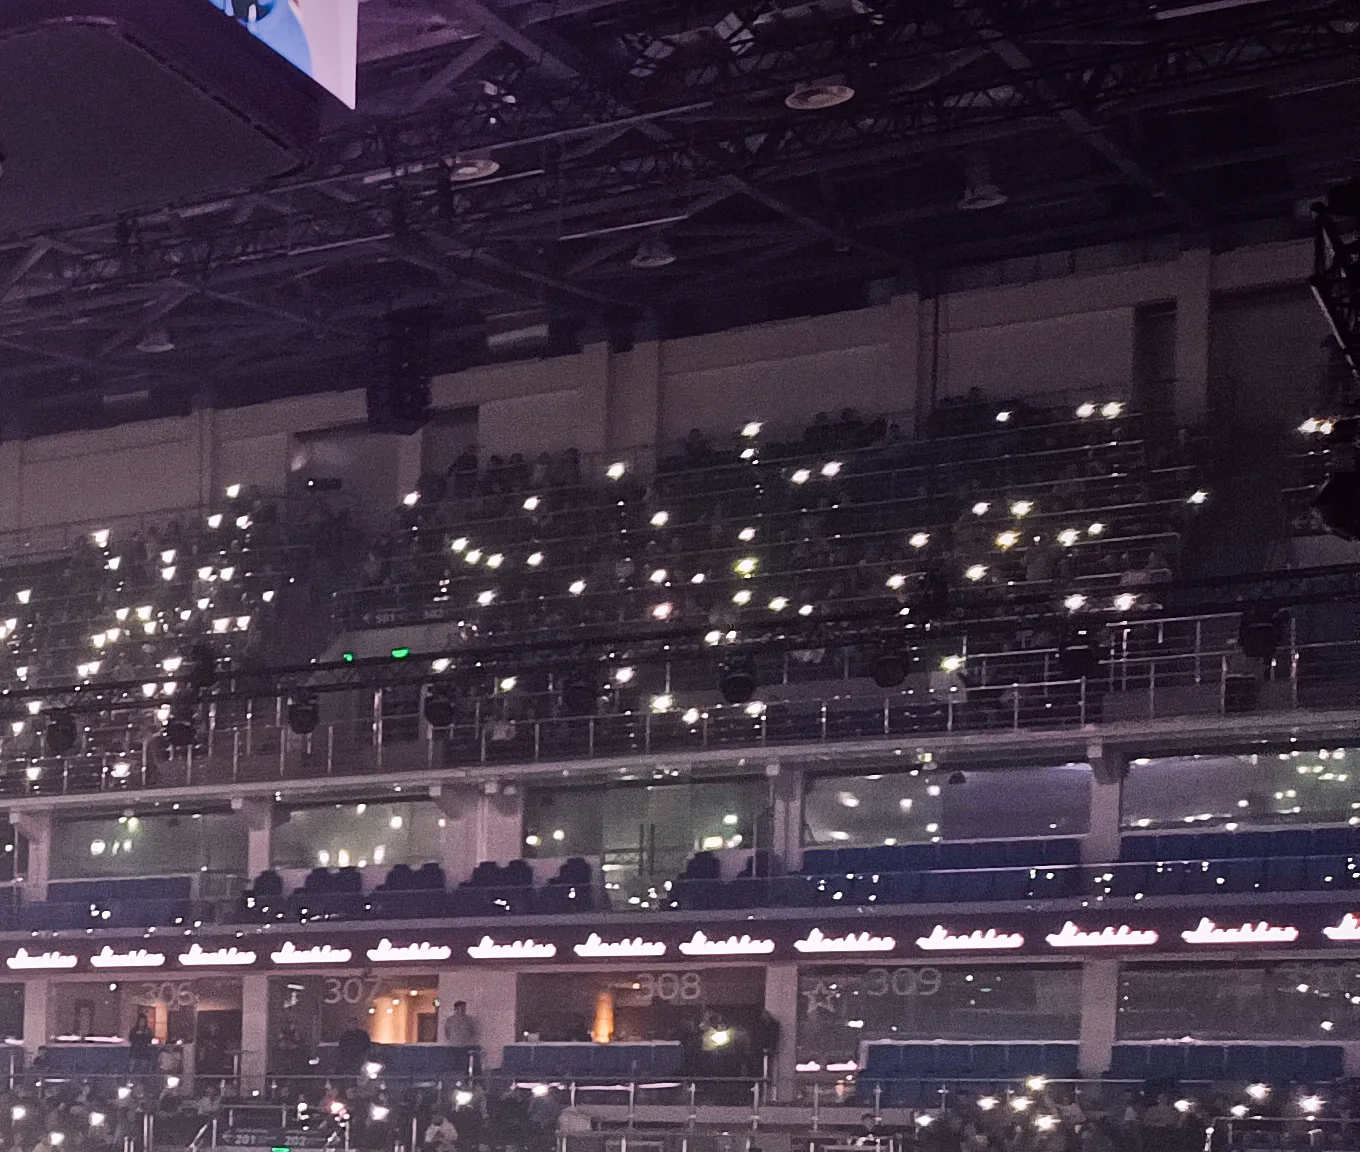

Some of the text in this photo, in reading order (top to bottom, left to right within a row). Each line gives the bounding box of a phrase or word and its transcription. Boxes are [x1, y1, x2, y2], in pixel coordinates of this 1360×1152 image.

[324, 977, 381, 1004] 307
[635, 973, 702, 1001] 308
[867, 968, 942, 996] 309
